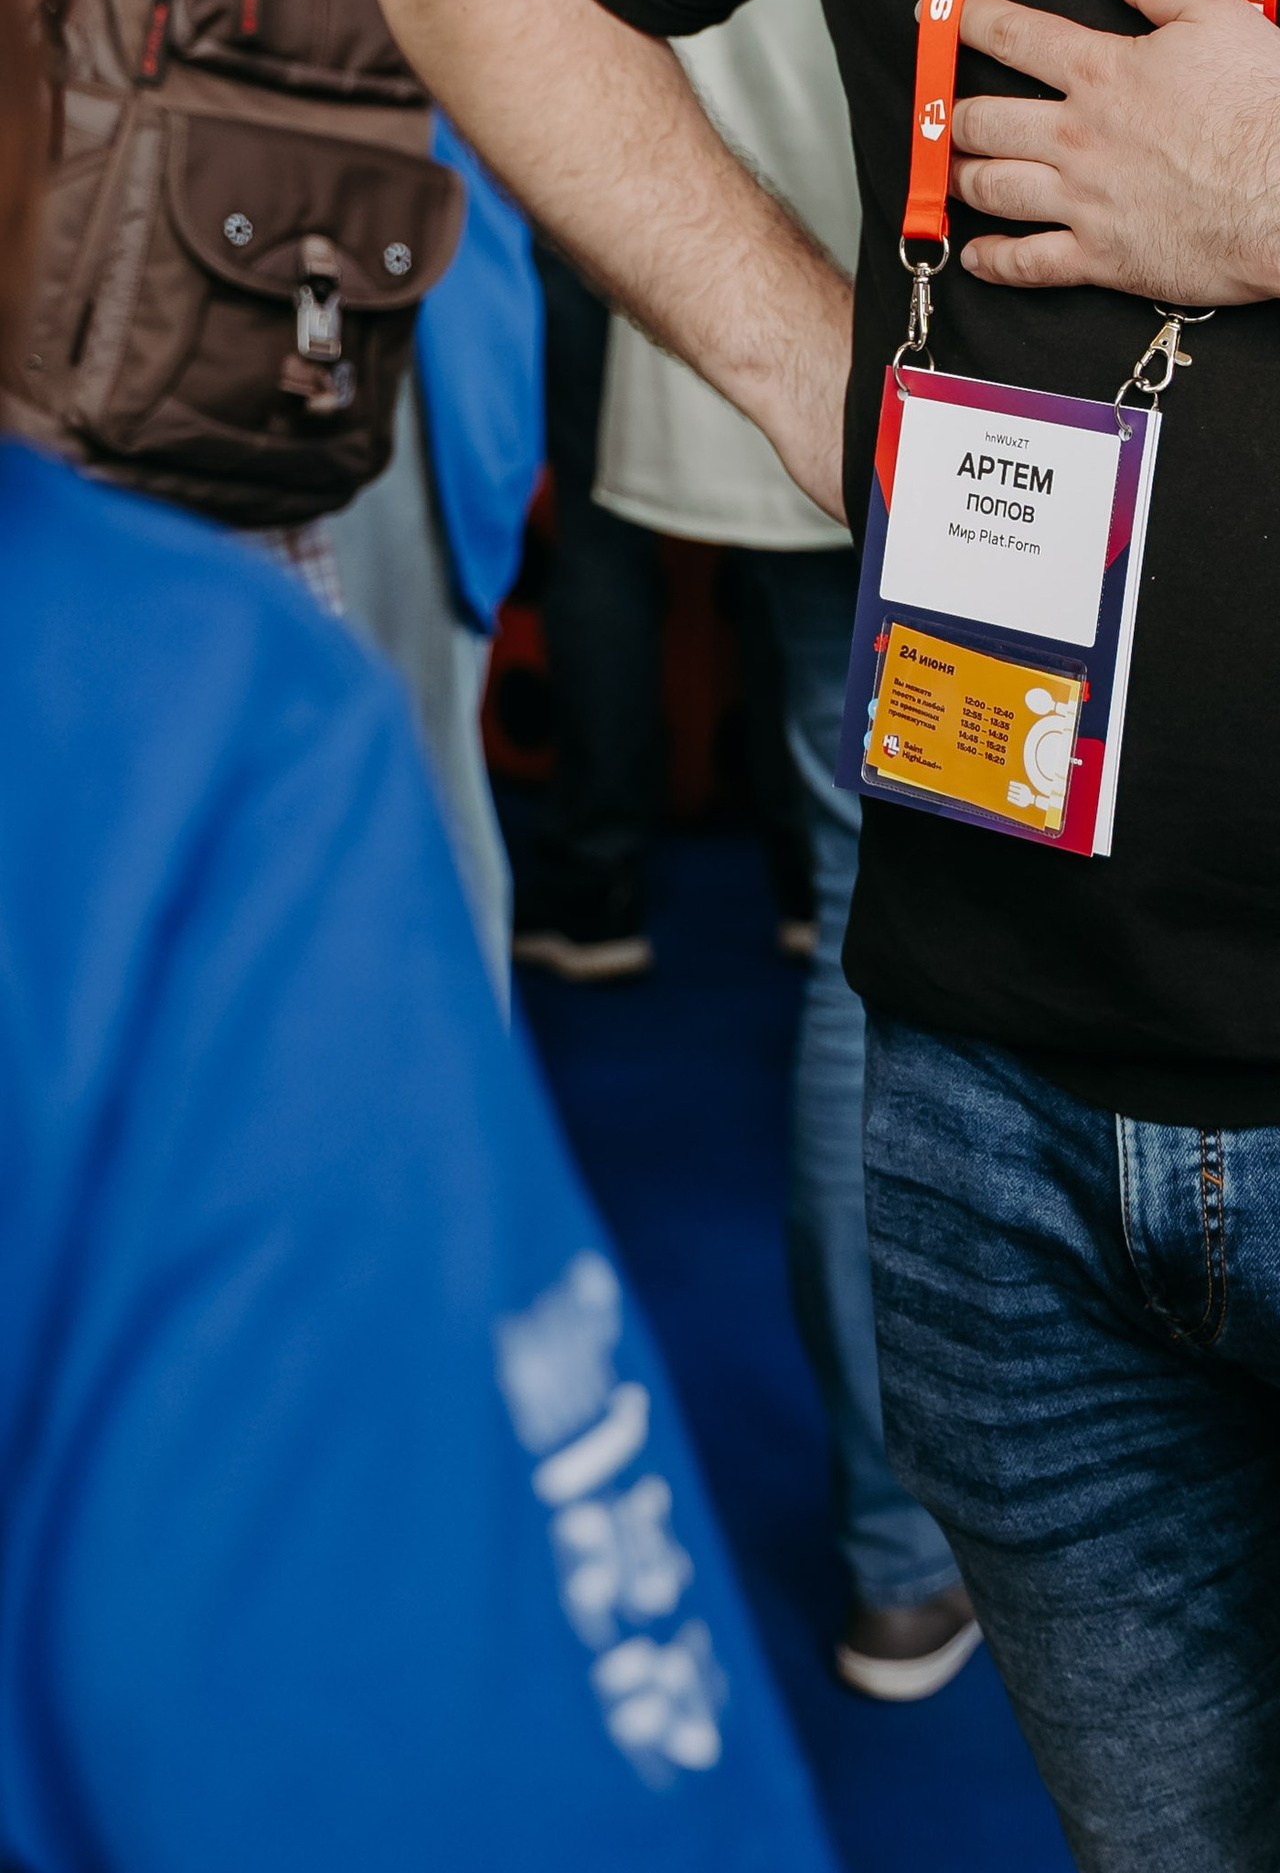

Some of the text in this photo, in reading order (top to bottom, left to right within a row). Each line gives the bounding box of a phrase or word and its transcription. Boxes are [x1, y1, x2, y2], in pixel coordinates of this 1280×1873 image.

[984, 431, 1030, 449] hnWUxZT
[956, 451, 1054, 495] АРТЕМ
[948, 522, 1041, 555] Мир Plat.Form
[899, 645, 955, 676] 24 июня
[963, 708, 983, 721] 12:55
[965, 696, 985, 709] 12:00
[993, 706, 1014, 720] 12:40
[903, 741, 923, 754] Saint
[957, 742, 977, 755] 15:40
[959, 730, 979, 743] 14:45
[986, 740, 1006, 754] 15:25
